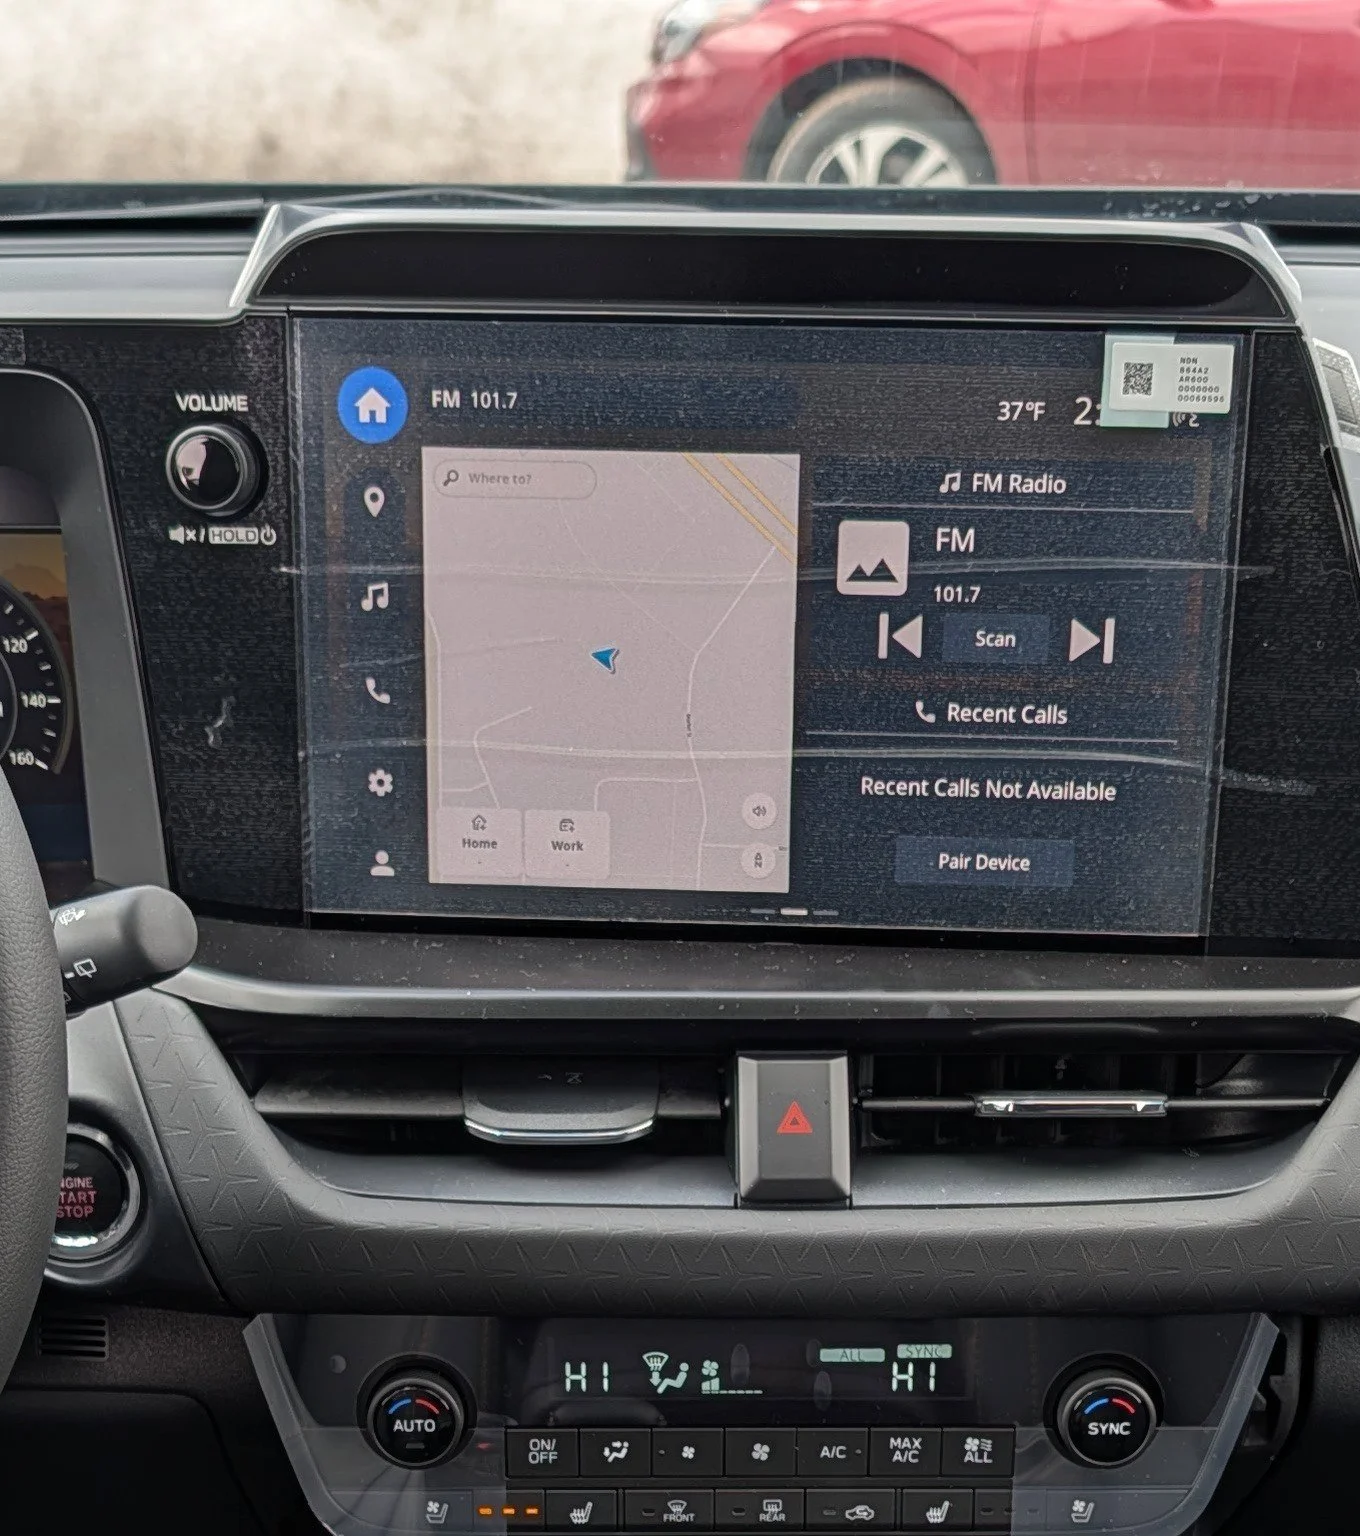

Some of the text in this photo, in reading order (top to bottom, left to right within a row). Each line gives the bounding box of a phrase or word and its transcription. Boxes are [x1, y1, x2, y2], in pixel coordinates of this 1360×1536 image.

[175, 393, 249, 412] VOLUME
[431, 389, 518, 410] FM 101.7
[996, 400, 1046, 421] 37°F
[468, 471, 532, 486] Where to?
[971, 473, 1067, 494] FM Radio
[211, 530, 257, 542] HOLD
[935, 526, 976, 553] FM
[933, 586, 981, 604] 101.7
[2, 638, 28, 654] 120
[974, 631, 1017, 649] Scan
[22, 692, 46, 708] 140
[947, 702, 1068, 725] Recent Calls
[9, 750, 35, 766] 160
[861, 776, 1117, 802] Recent Calls Not Available
[461, 838, 498, 850] Home
[551, 840, 584, 852] Work
[938, 852, 1031, 873] Pair Device
[60, 1176, 94, 1189] GINE
[59, 1191, 97, 1203] TART
[56, 1205, 94, 1218] STOP
[839, 1349, 865, 1362] ALL
[904, 1345, 942, 1358] SYNC
[393, 1419, 436, 1433] AUTO
[1087, 1422, 1132, 1436] SYNC
[529, 1438, 556, 1452] ON/
[889, 1437, 922, 1450] MAX
[528, 1451, 558, 1465] OFF
[819, 1445, 847, 1460] A/C
[892, 1450, 920, 1464] A/C
[963, 1449, 993, 1464] ALL
[663, 1513, 696, 1523] FRONT
[759, 1512, 786, 1522] REAR
